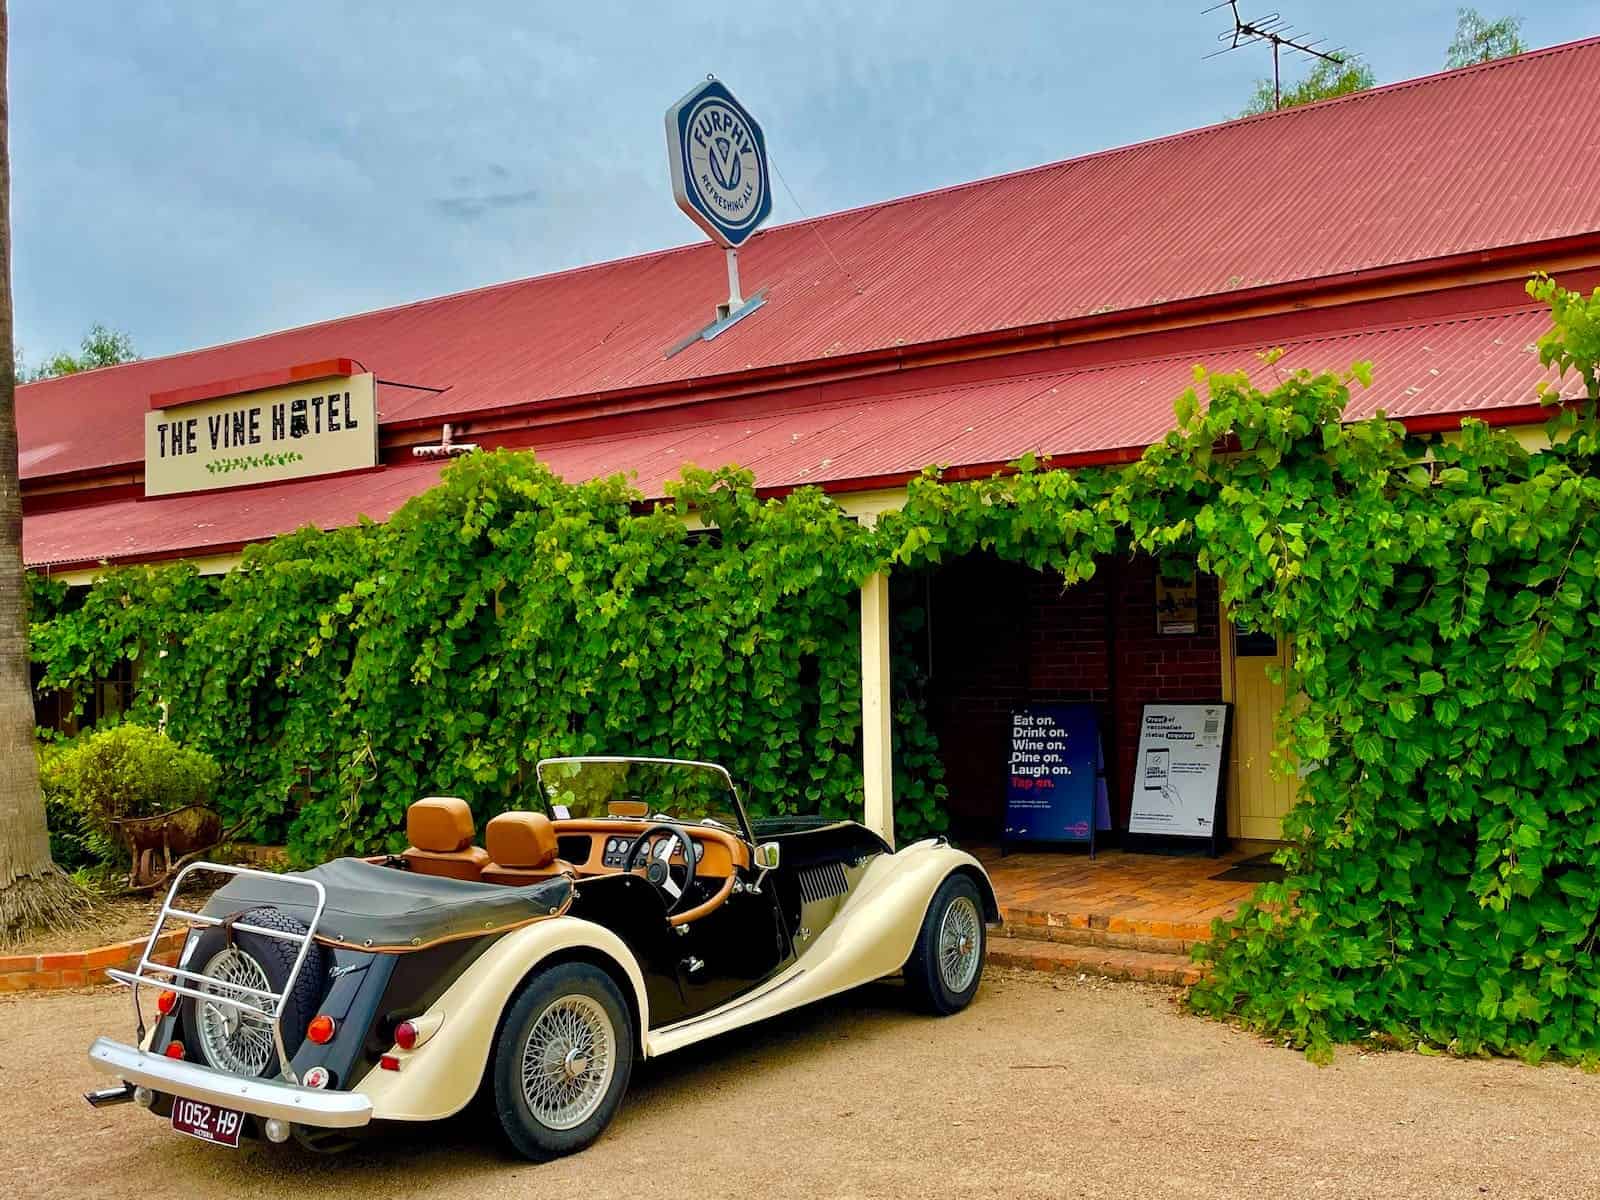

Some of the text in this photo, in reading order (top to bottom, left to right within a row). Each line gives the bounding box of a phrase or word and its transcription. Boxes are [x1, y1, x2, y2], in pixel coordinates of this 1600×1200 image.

[694, 111, 752, 155] FURPHY
[701, 174, 744, 212] REFRESHING
[157, 392, 358, 458] THE VINE HOTEL
[1013, 715, 1056, 726] Eat on.
[1013, 727, 1069, 738] Drink on.
[1012, 739, 1066, 750] Wine on.
[1011, 752, 1063, 763] Dine on.
[1011, 764, 1072, 777] Laugh on.
